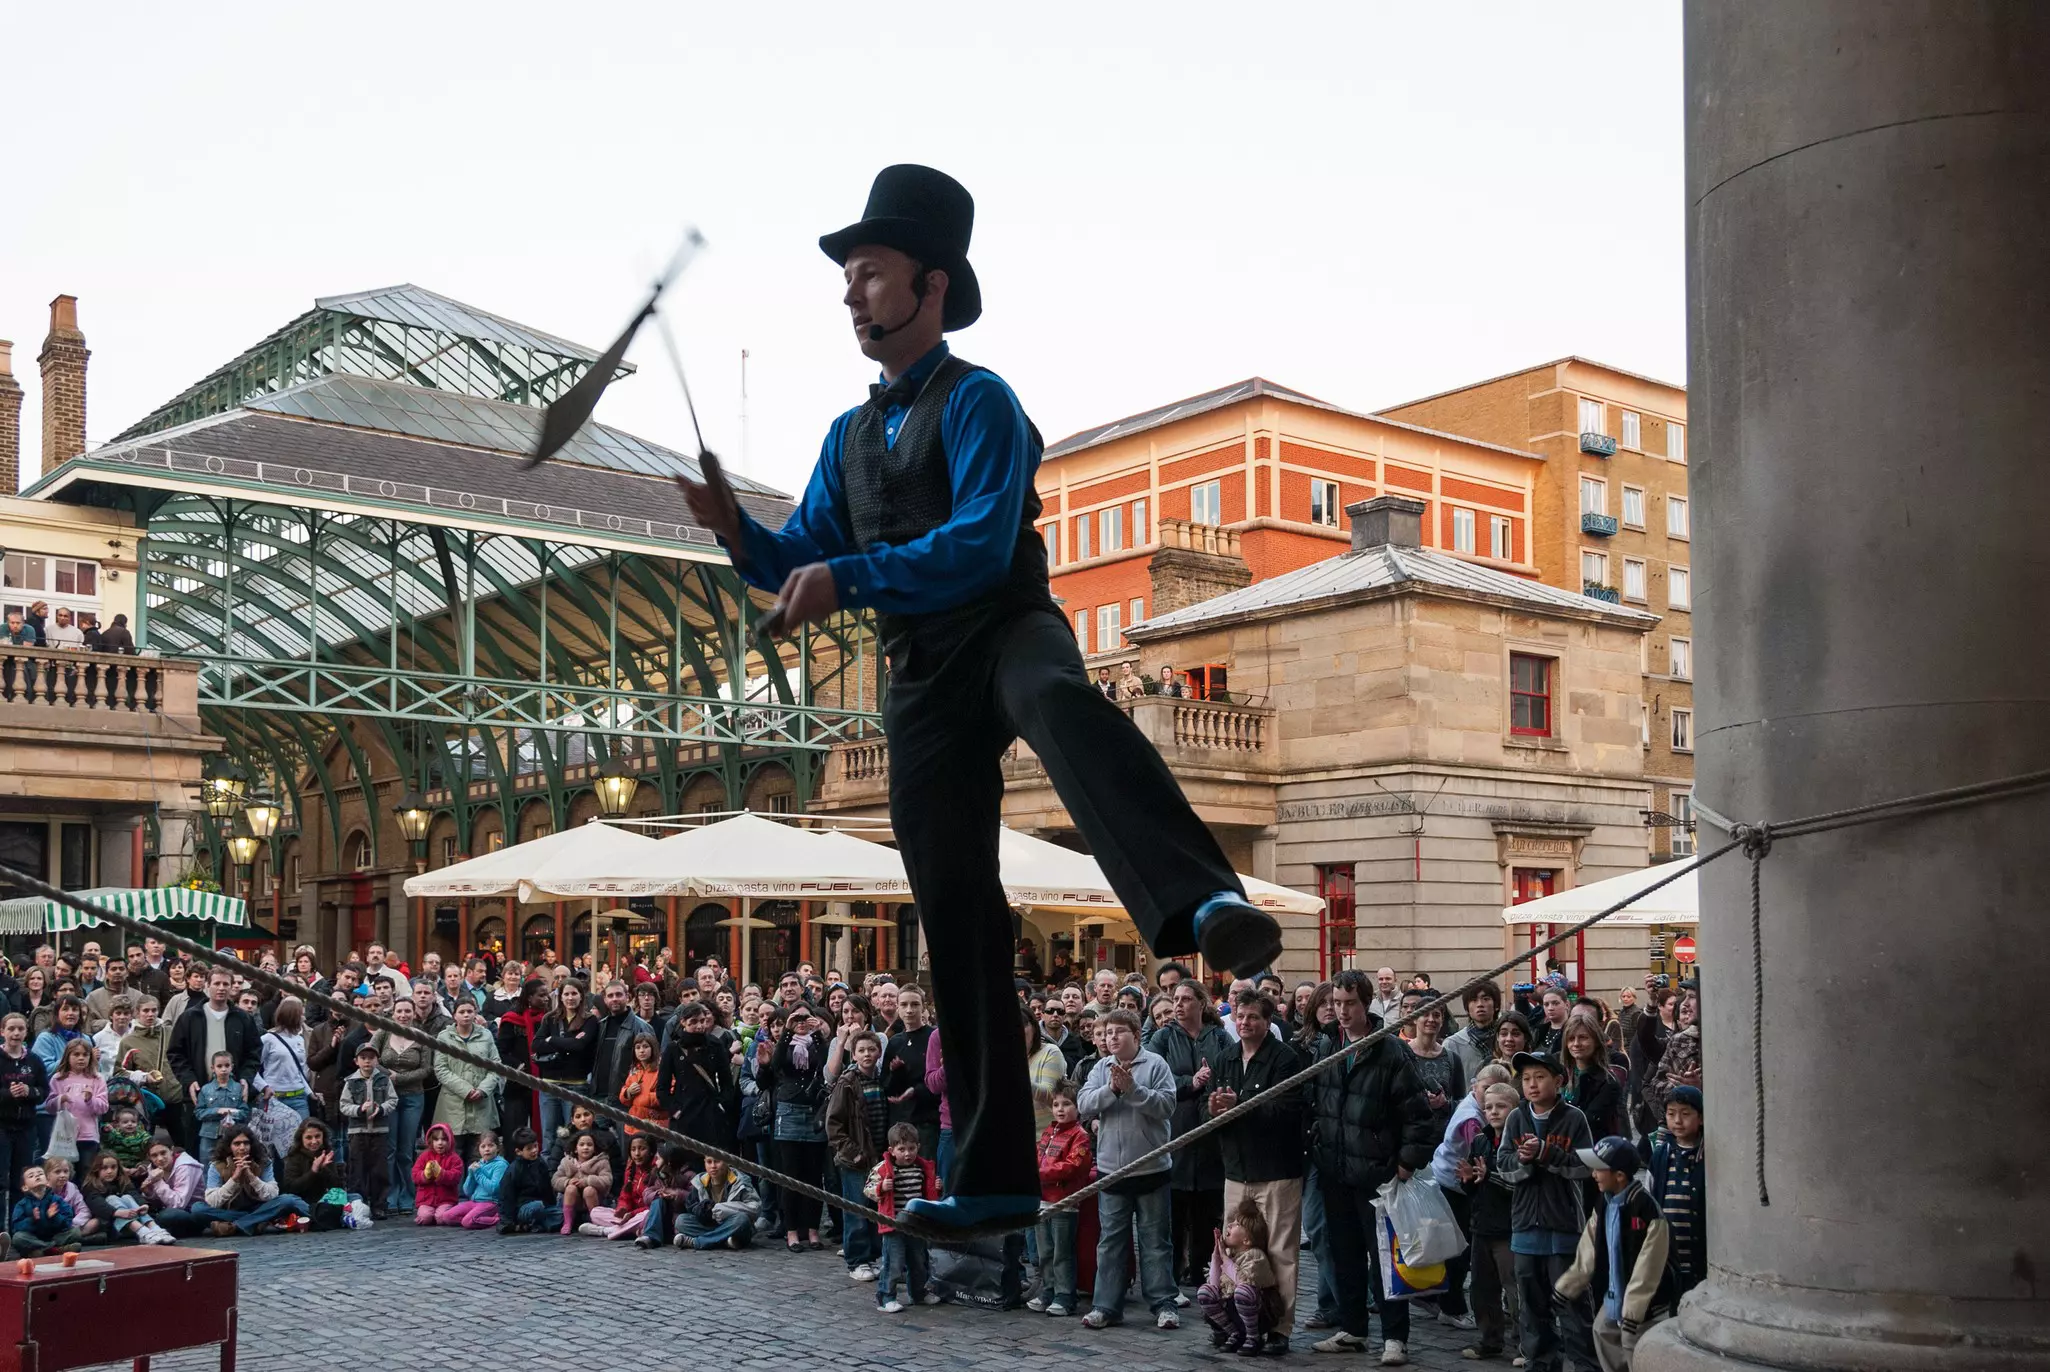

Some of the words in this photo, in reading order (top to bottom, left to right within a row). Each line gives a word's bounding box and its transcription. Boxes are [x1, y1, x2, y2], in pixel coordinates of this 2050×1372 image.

[588, 884, 624, 892] FUEL
[705, 883, 734, 895] pizza
[737, 882, 769, 894] pasta
[773, 881, 795, 892] vino
[800, 883, 864, 891] FUEL
[875, 880, 898, 891] café
[1013, 890, 1037, 902] pasta
[1040, 890, 1059, 901] vino
[1062, 893, 1114, 903] FUEL
